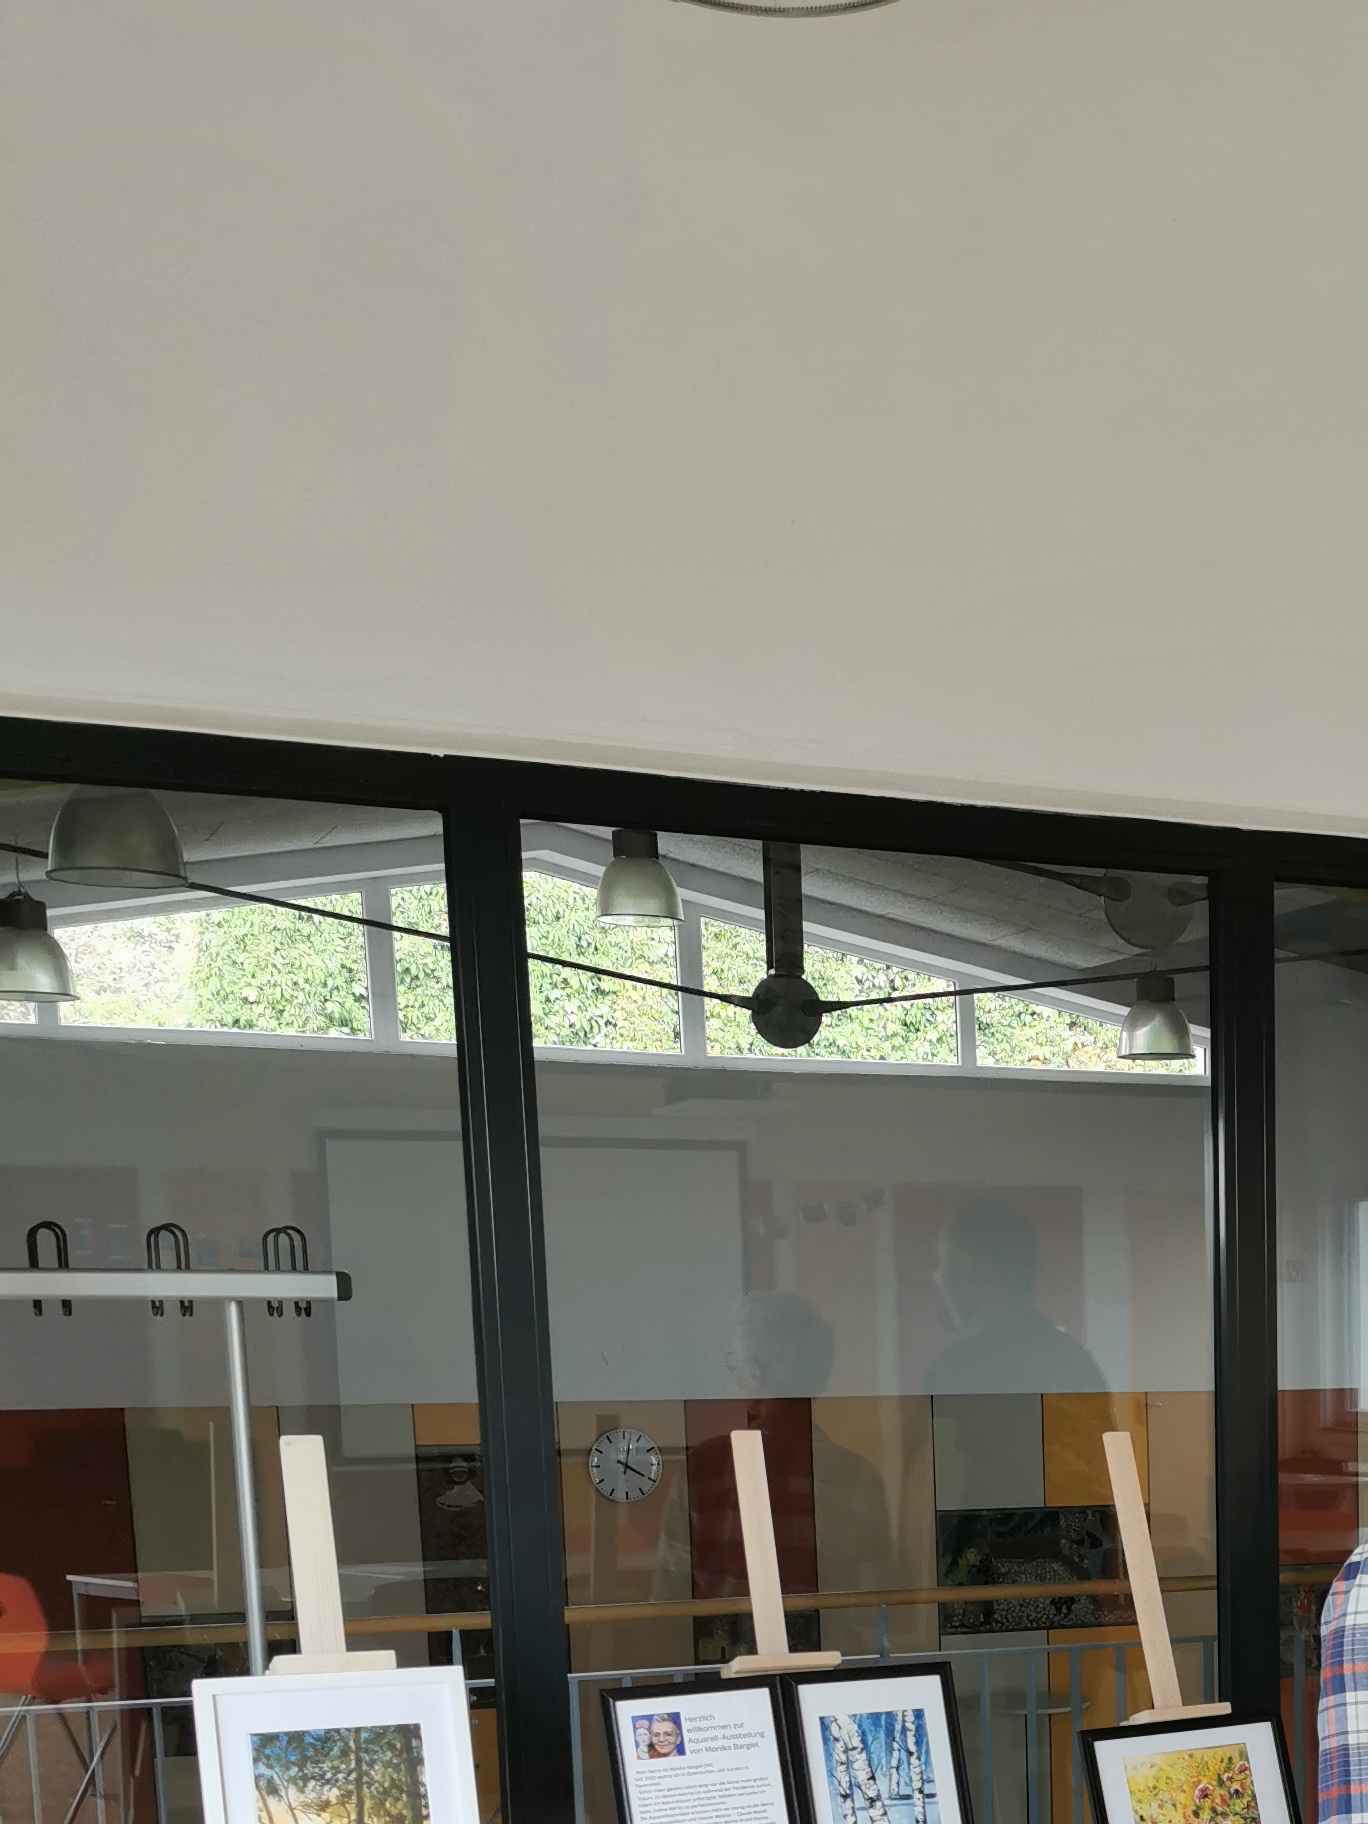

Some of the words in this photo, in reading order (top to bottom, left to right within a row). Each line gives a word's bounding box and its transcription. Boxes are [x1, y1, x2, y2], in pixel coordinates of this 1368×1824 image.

[684, 1713, 715, 1723] Herzlich
[685, 1722, 731, 1733] willkommen
[687, 1730, 765, 1745] Aquarell-Ausstellung
[704, 1743, 731, 1753] Monika
